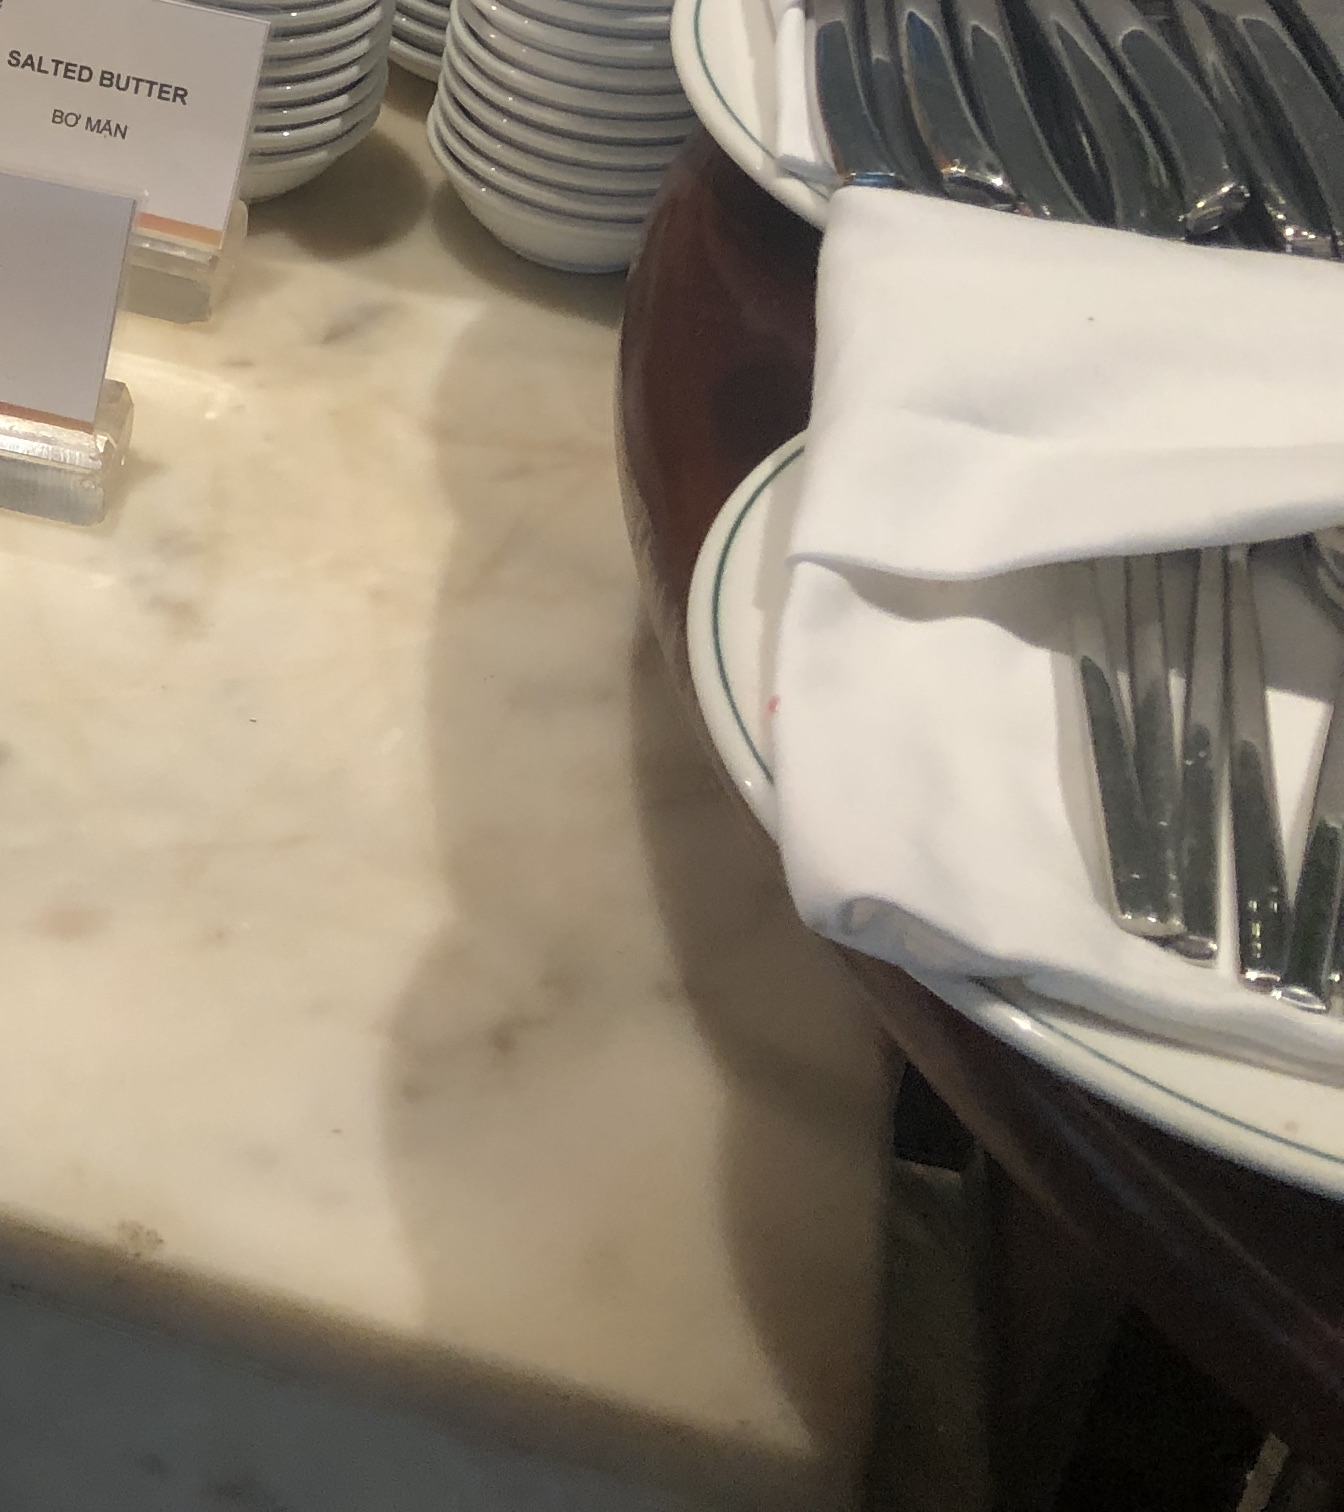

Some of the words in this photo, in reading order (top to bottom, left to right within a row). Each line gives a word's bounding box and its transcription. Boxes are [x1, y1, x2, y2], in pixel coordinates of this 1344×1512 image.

[7, 50, 93, 83] SALTED
[99, 70, 189, 105] BUTTER
[52, 109, 81, 128] BƠ
